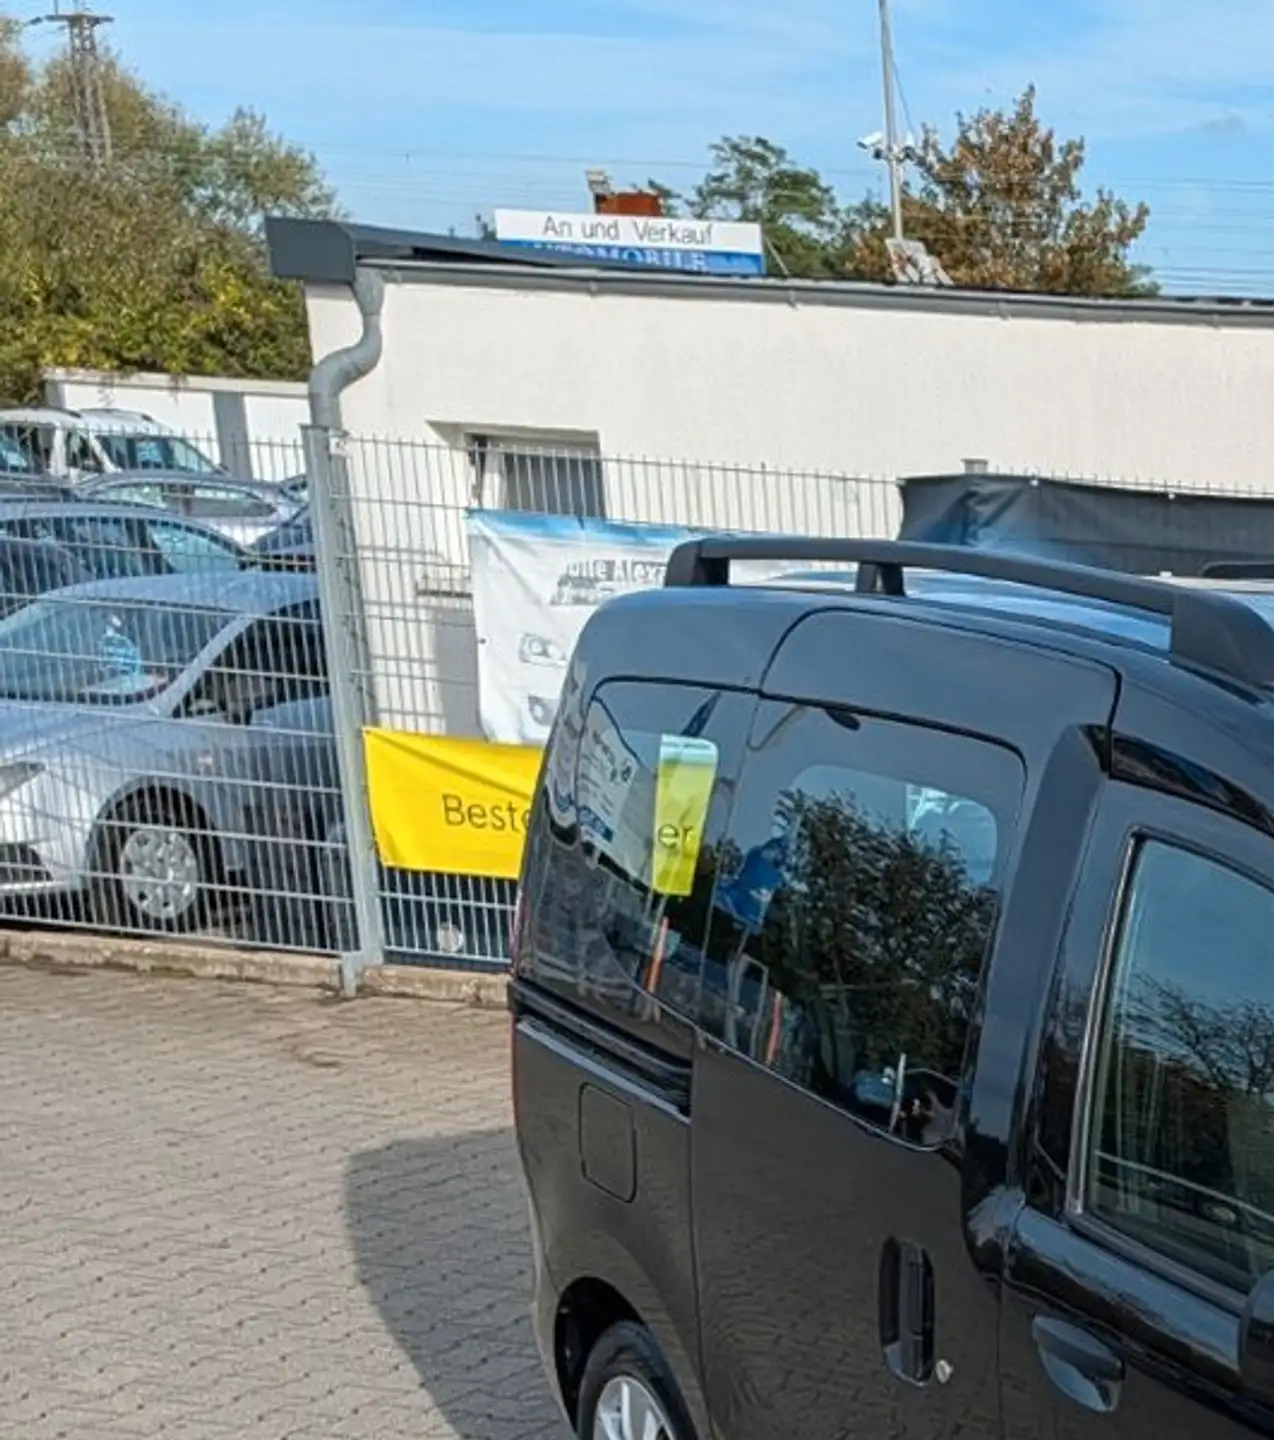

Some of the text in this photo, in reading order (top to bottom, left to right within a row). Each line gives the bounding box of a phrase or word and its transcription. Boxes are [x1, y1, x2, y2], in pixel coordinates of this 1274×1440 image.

[541, 215, 714, 245] An und Verkauf
